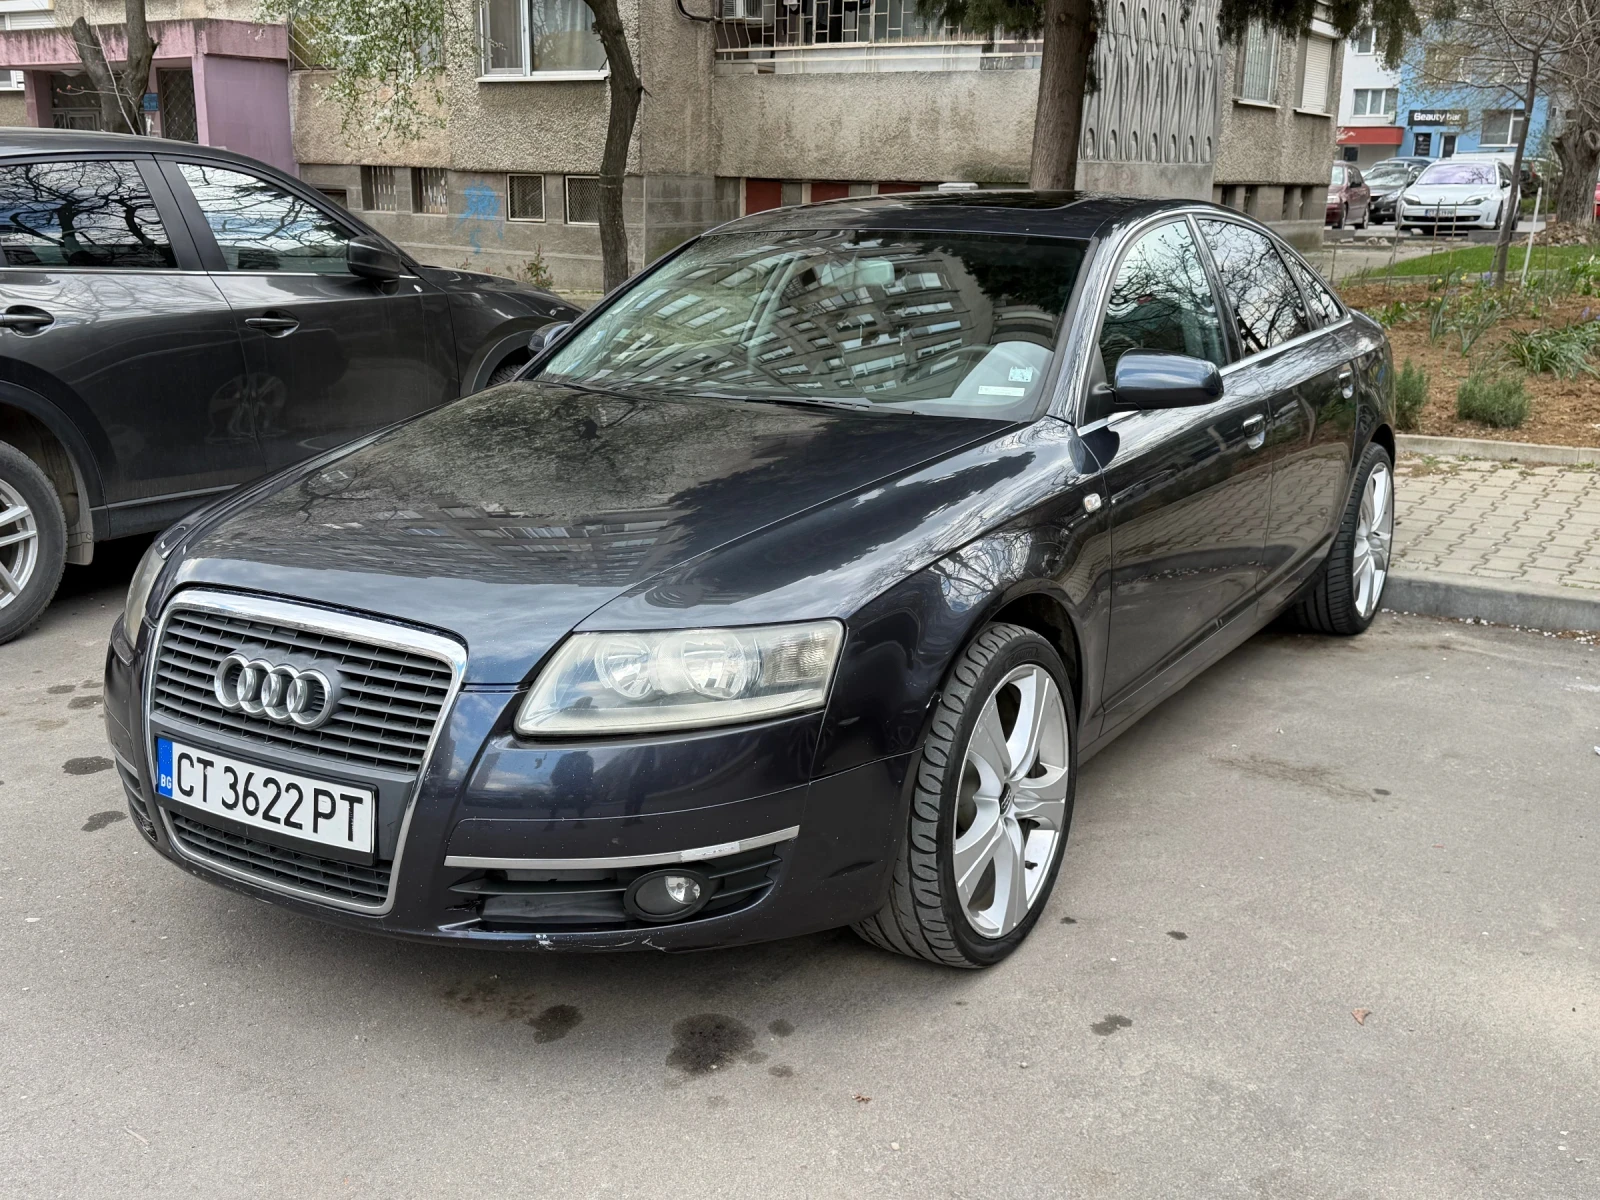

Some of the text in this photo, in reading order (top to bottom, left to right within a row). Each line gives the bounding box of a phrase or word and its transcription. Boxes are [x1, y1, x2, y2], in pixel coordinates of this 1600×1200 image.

[1414, 112, 1461, 122] Beauty bar
[160, 773, 172, 789] BG
[221, 766, 304, 830] 3622
